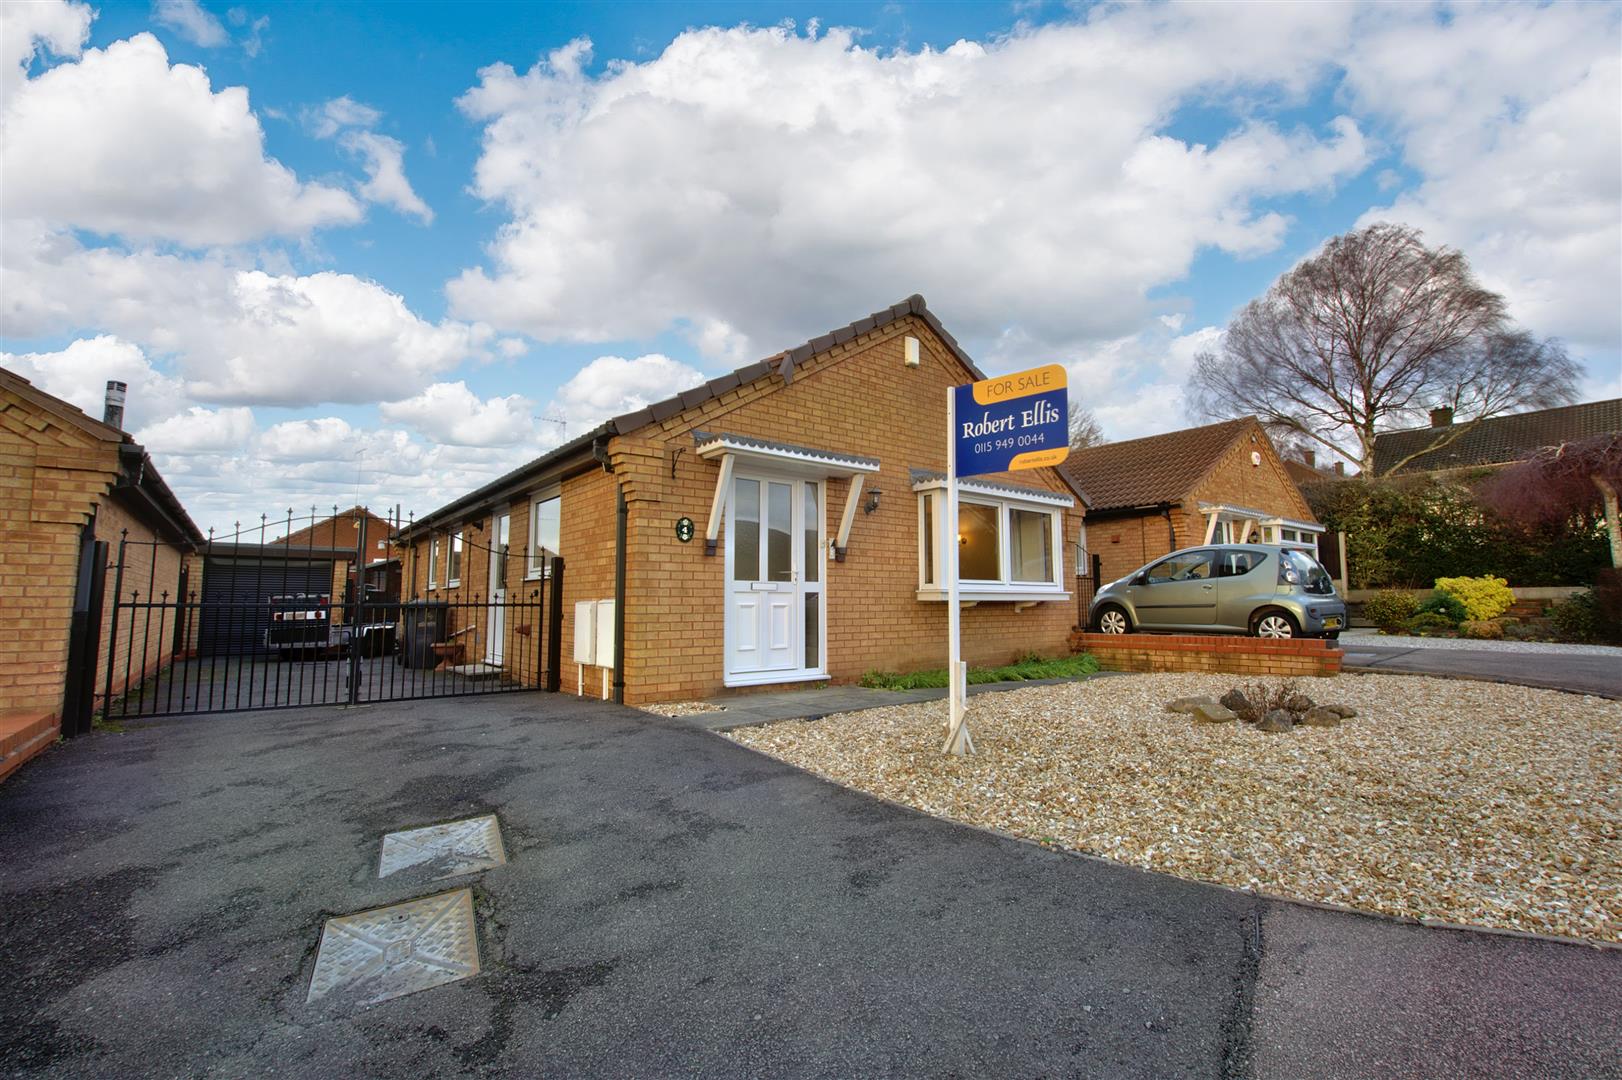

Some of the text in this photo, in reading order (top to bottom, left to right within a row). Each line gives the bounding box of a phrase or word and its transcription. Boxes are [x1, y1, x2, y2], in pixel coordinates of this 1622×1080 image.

[987, 372, 1050, 398] FOR SALE
[962, 399, 1059, 439] Robert Ellis
[974, 432, 1045, 454] 0115 949 0044
